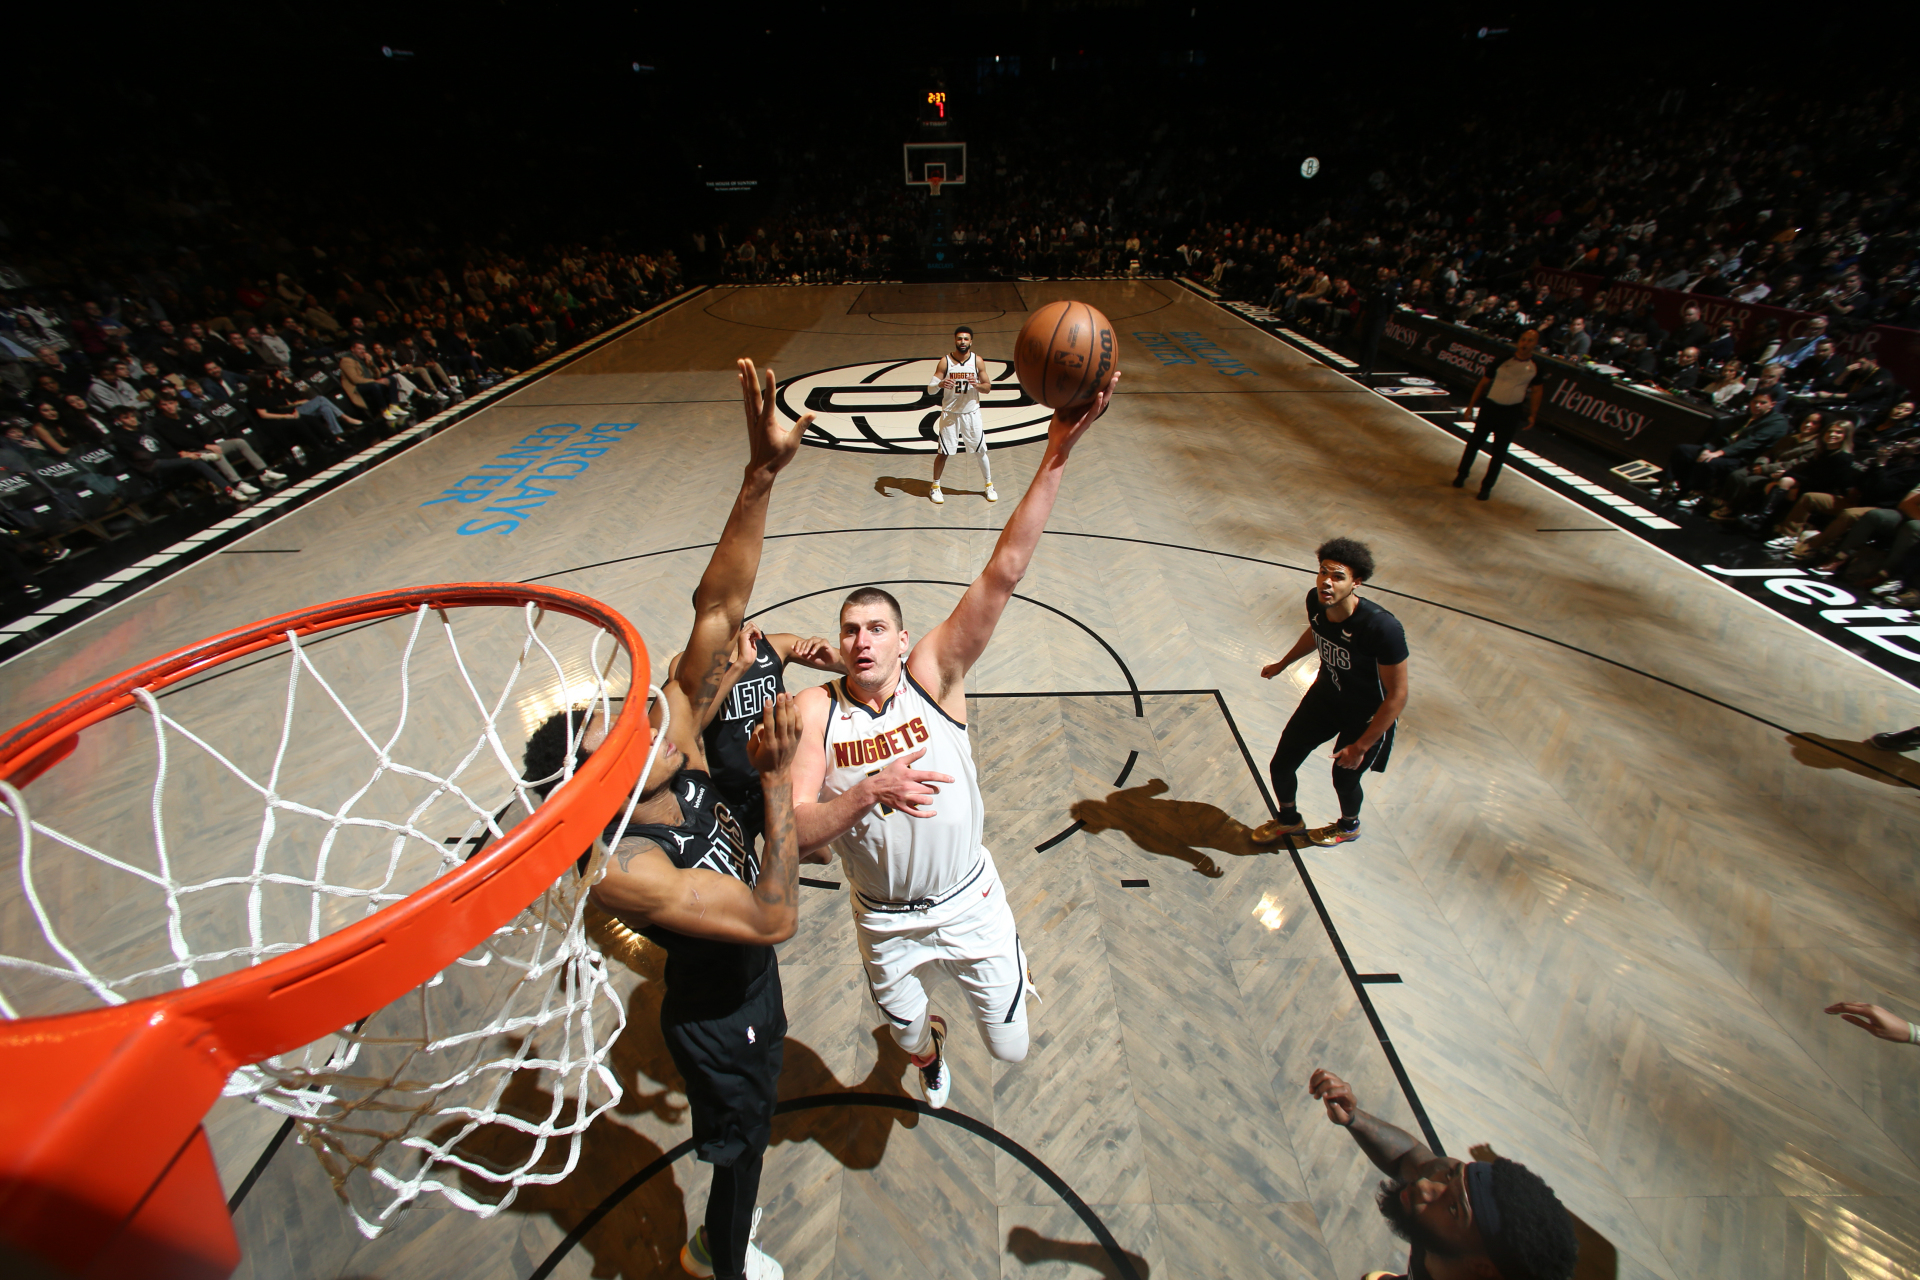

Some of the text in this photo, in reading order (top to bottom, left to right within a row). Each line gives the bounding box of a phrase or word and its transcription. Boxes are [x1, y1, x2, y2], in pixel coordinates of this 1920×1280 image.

[935, 102, 944, 118] 7
[1132, 331, 1197, 366] CENTER
[1168, 331, 1260, 376] BARCLAYS
[1448, 342, 1496, 365] SPIRIT OF
[1436, 350, 1488, 376] BROOKLYN
[955, 380, 969, 394] 27
[1549, 378, 1654, 441] Hennessy
[80, 448, 110, 463] QATAR
[418, 423, 582, 508] CENTER
[36, 462, 73, 477] QATAR
[456, 422, 640, 536] BARCLAYS
[0, 475, 26, 491] ATAR
[832, 716, 930, 769] NUGGETS
